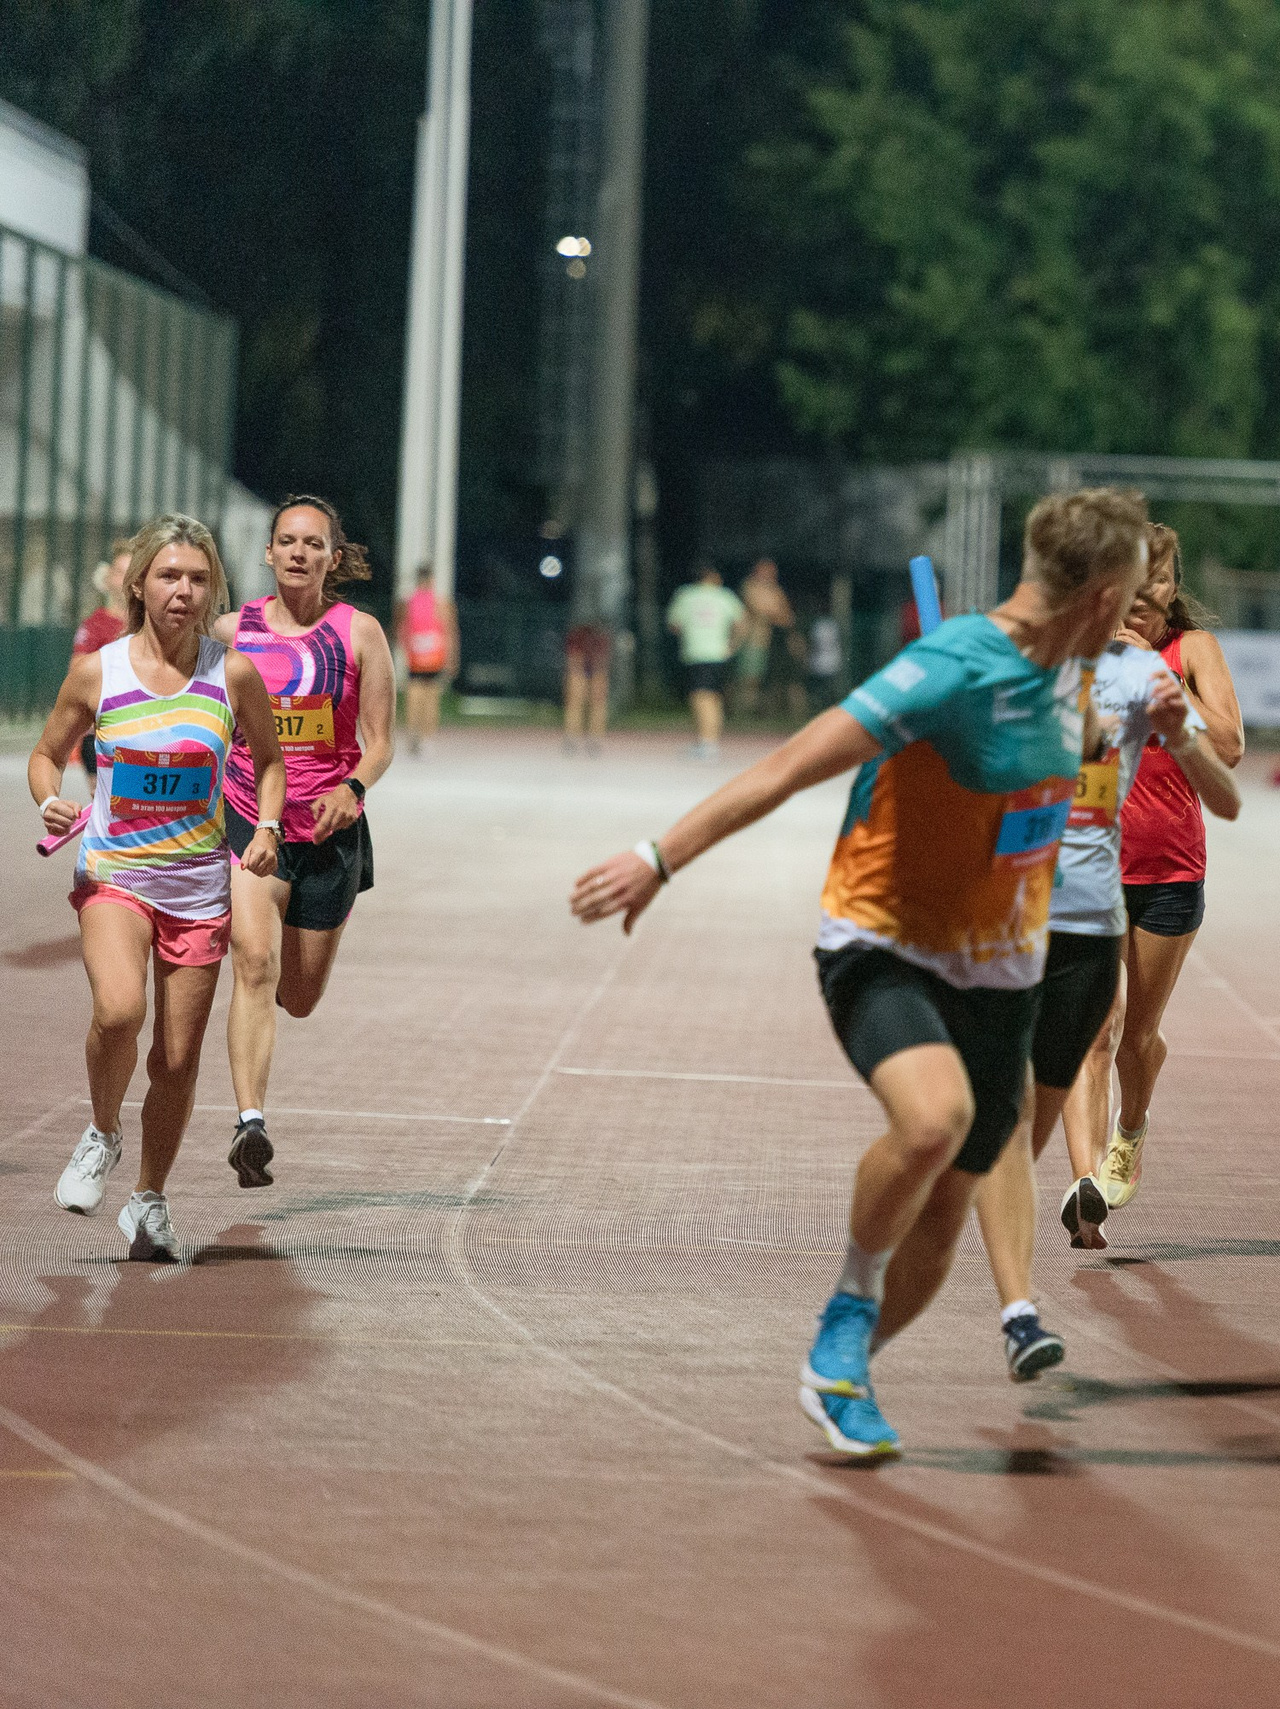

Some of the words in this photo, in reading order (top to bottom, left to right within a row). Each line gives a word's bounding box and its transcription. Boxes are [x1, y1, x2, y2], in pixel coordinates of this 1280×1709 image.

[316, 723, 324, 735] 2
[143, 773, 182, 795] 317
[192, 782, 201, 795] 3
